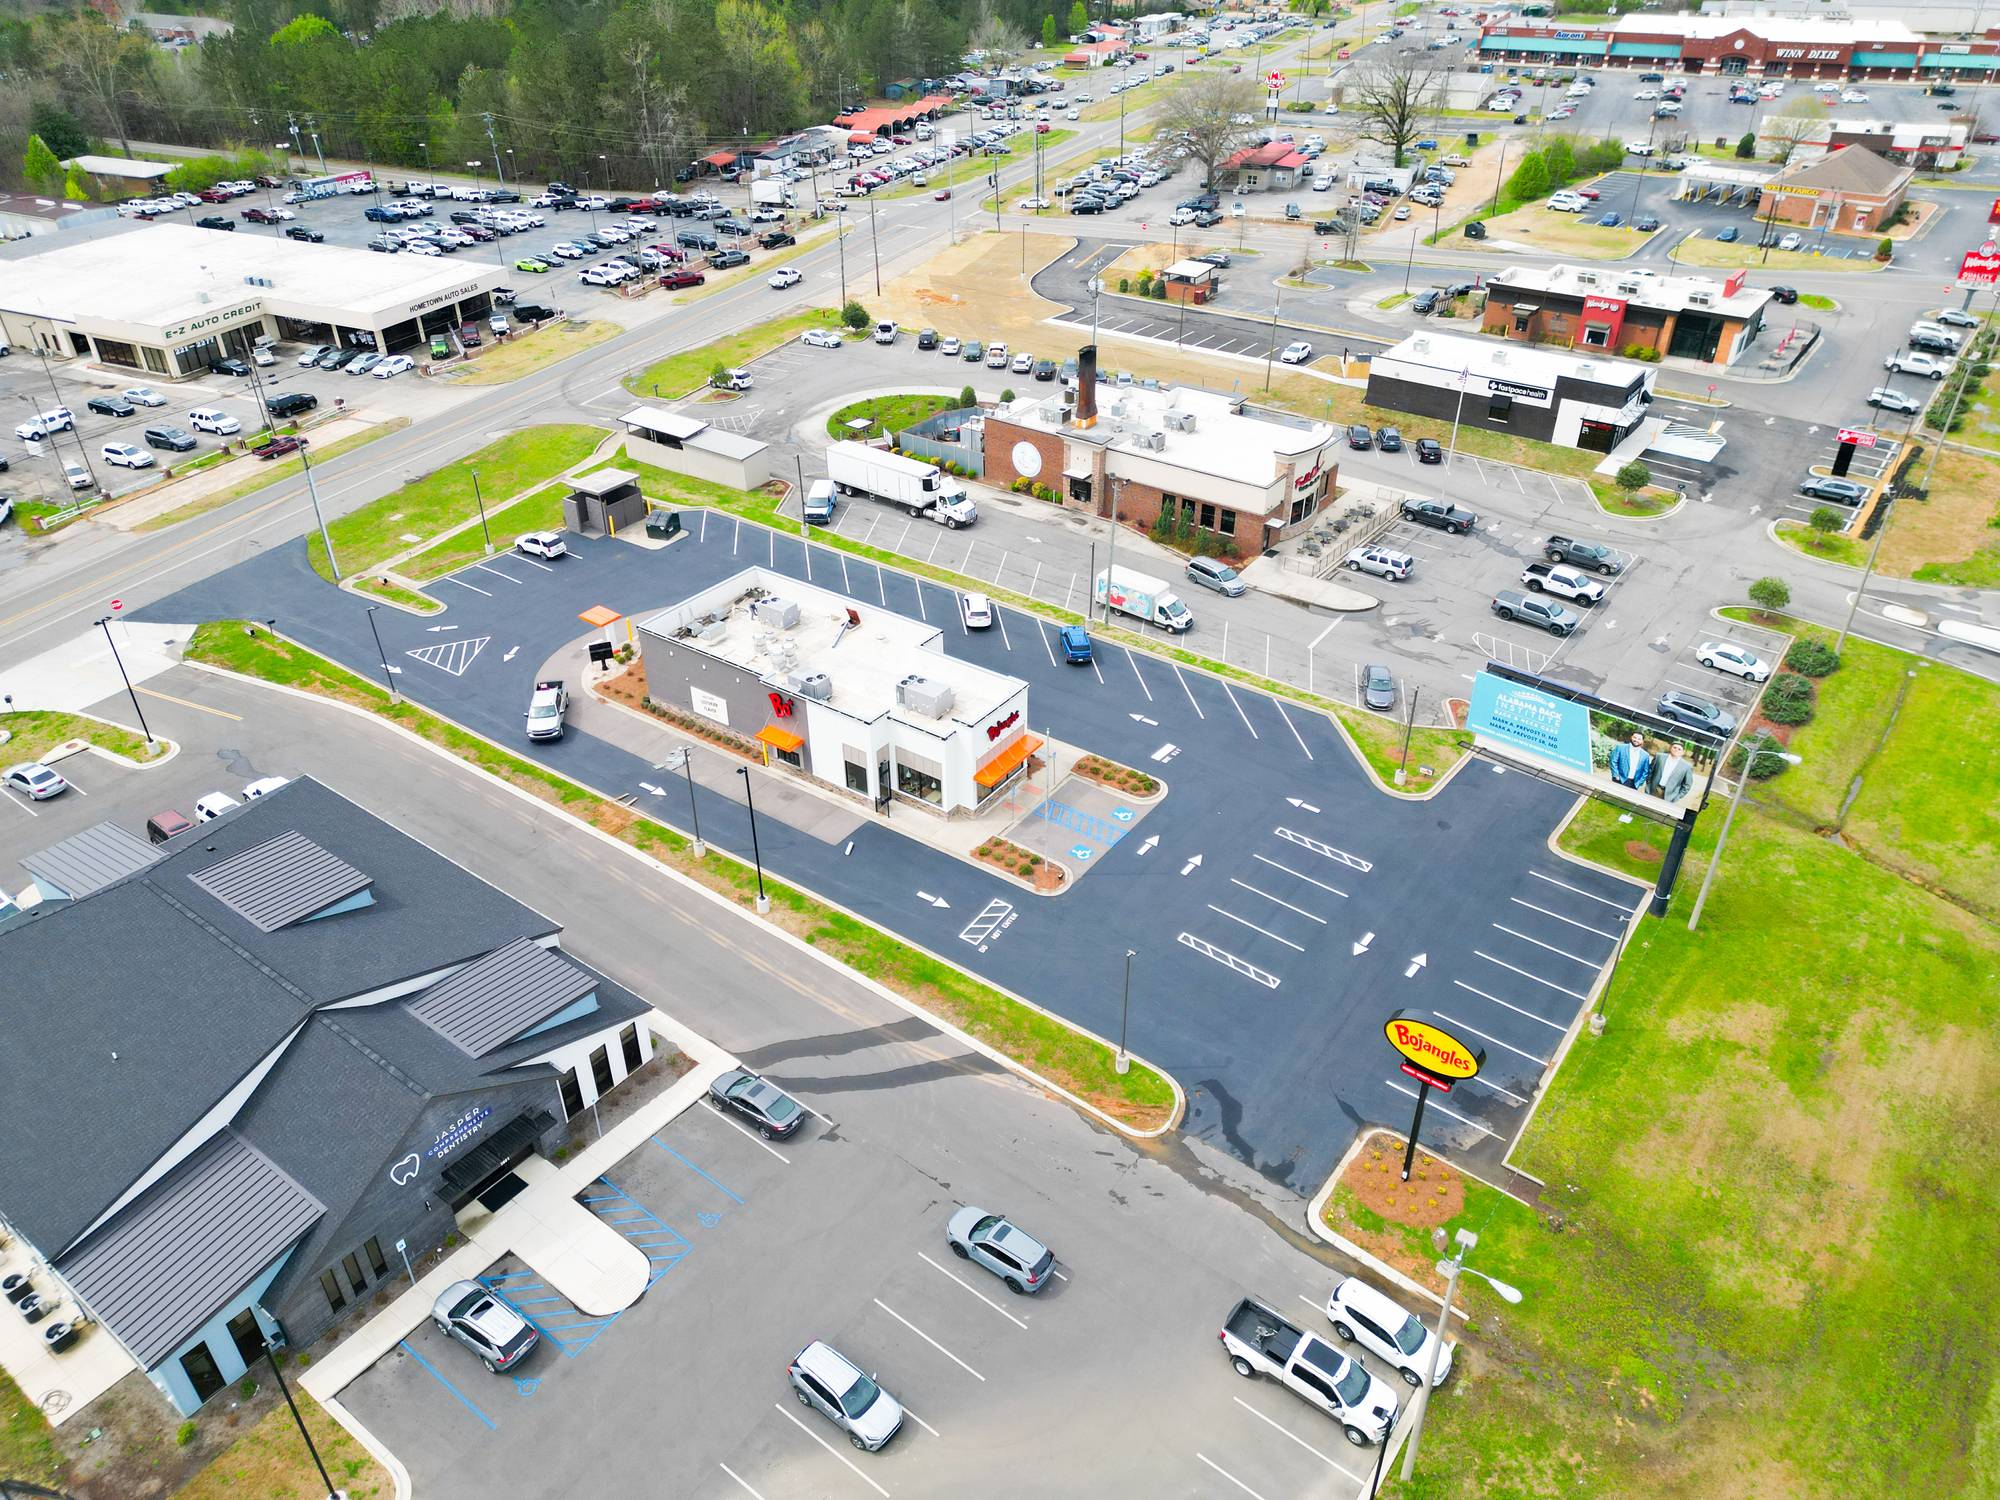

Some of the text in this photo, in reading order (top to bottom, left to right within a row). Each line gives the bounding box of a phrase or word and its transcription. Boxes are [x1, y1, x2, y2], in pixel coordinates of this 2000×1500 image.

[1776, 49, 1839, 60] WINN DIXIE
[409, 283, 478, 312] HOMETOWN AUTO SALES
[165, 302, 261, 339] E-Z AUTO CREDIT
[1495, 699, 1561, 728] INSTITUTE
[1497, 693, 1562, 721] ALABAMA BACK
[1489, 722, 1505, 731] MARK
[1513, 730, 1538, 742] PREVOST
[1492, 716, 1508, 725] MARK
[1516, 724, 1540, 736] PREVOST
[1394, 1024, 1470, 1071] Bojangles
[428, 1110, 489, 1156] COMPREHENSIVE
[434, 1107, 480, 1144] JASPER
[437, 1121, 483, 1158] DENTISTRY
